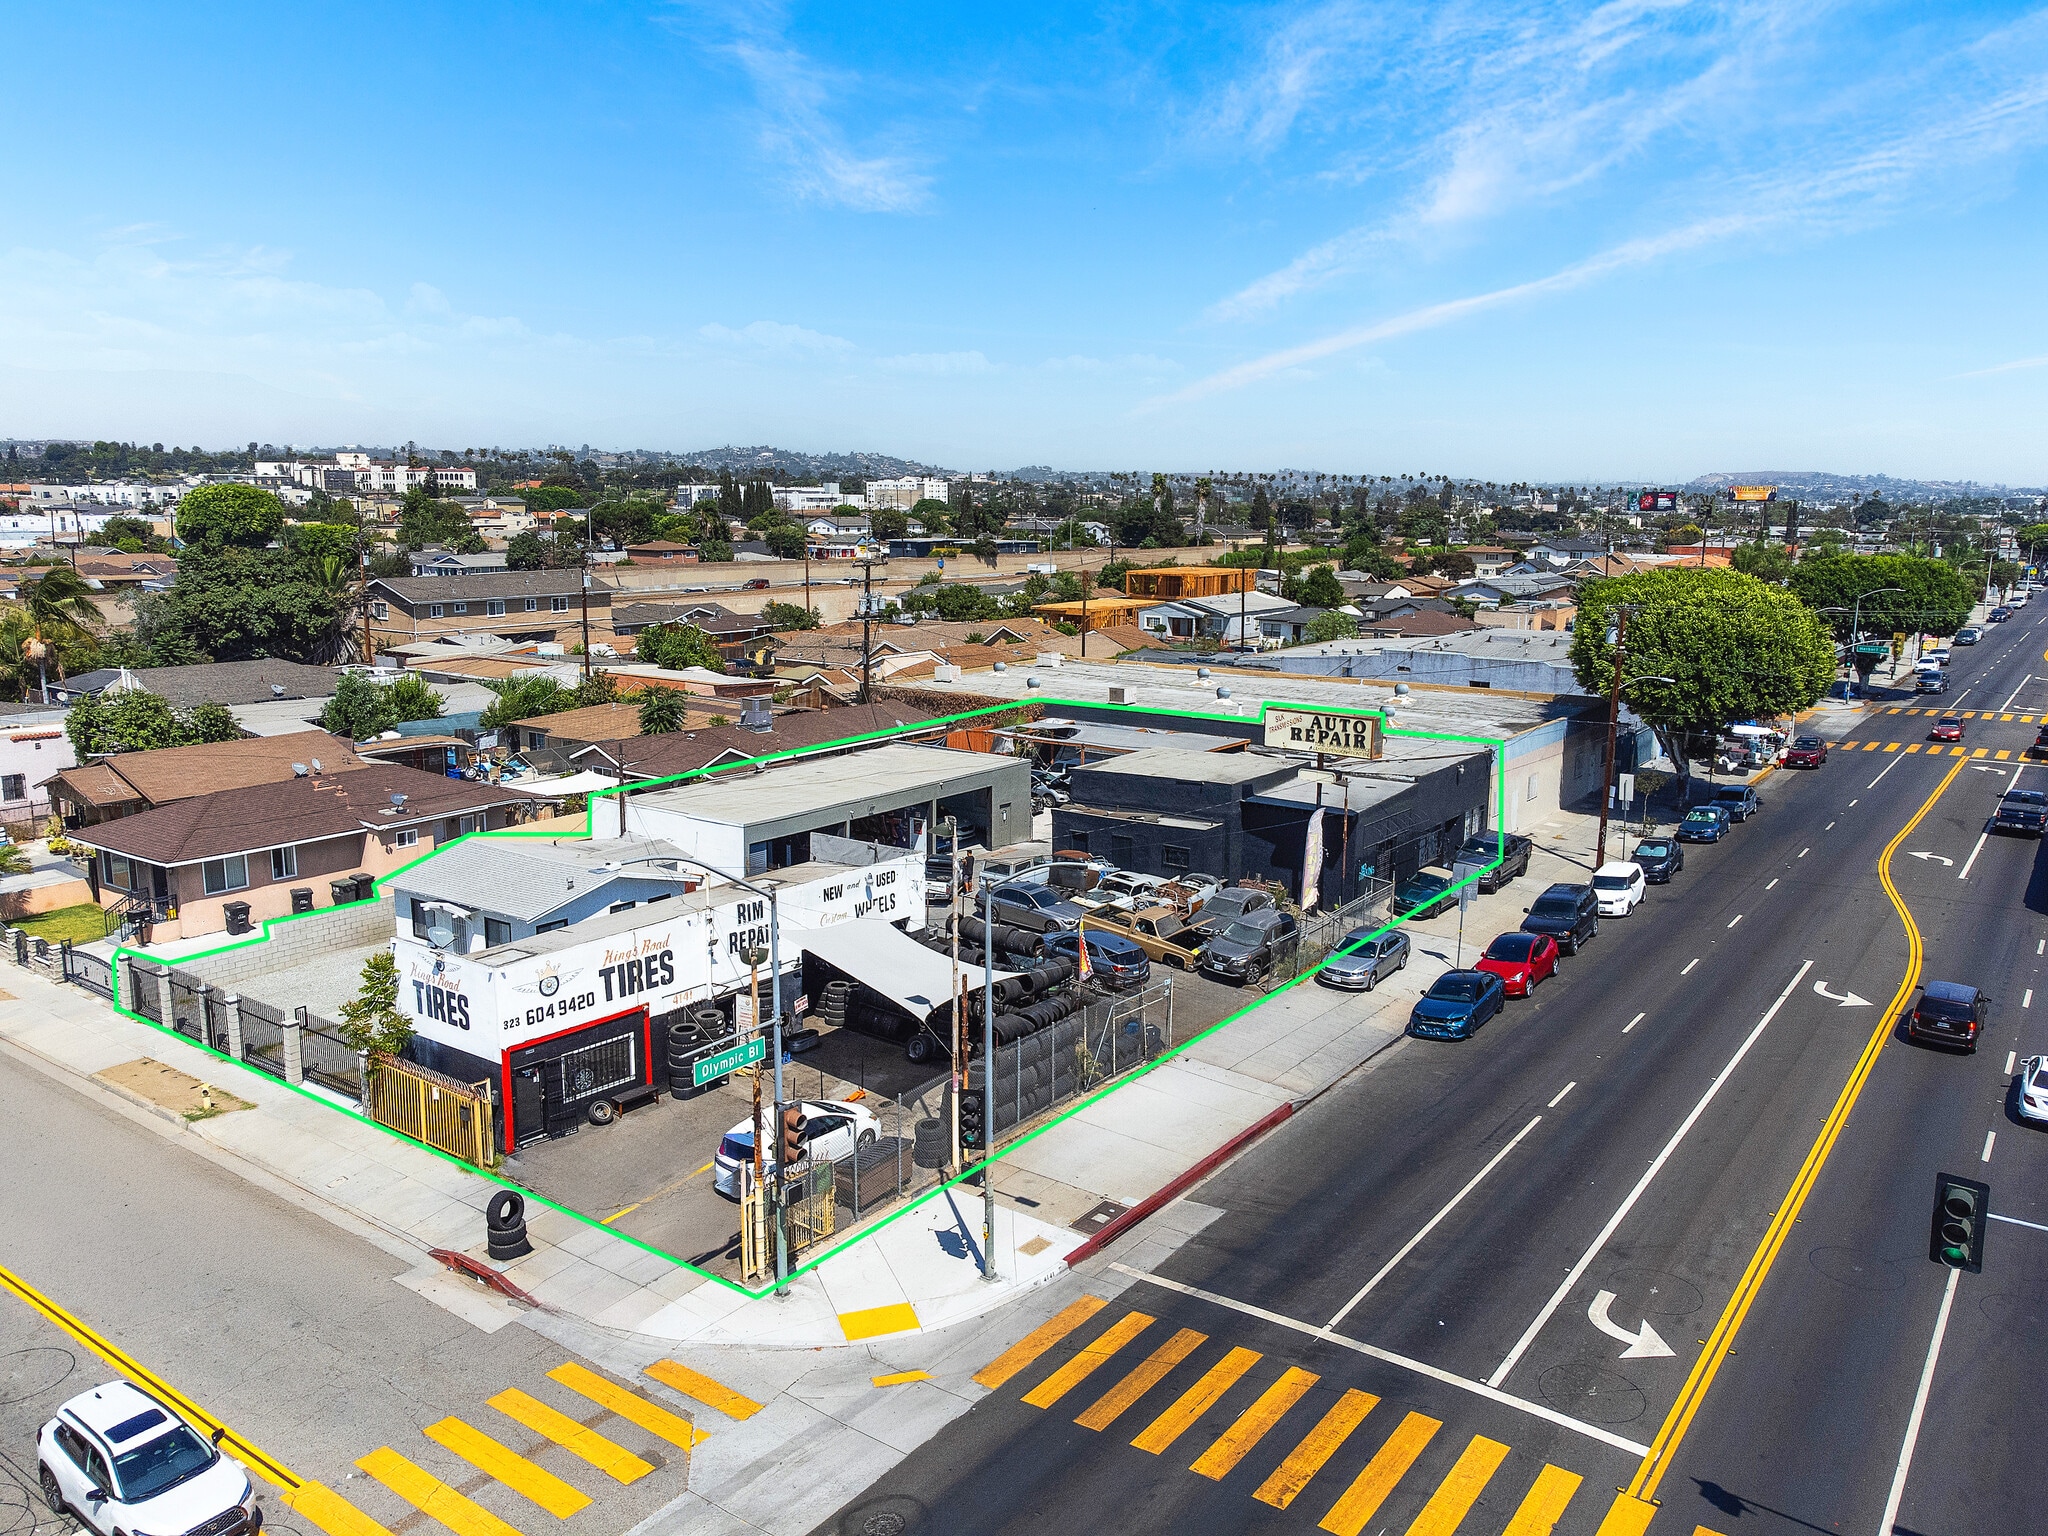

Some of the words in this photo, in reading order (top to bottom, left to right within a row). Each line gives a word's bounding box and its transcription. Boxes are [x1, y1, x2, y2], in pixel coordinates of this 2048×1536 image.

[1311, 715, 1367, 734] AUTO
[1290, 727, 1366, 749] REPAIR
[823, 884, 844, 903] NEW
[846, 879, 861, 890] and
[875, 870, 896, 888] USED
[736, 900, 764, 925] RIM
[641, 932, 671, 956] Road
[437, 972, 461, 992] Road
[599, 949, 675, 1002] TIRES
[412, 979, 471, 1031] TIRES
[672, 989, 693, 1005] 4141
[503, 1017, 520, 1030] 323
[526, 1003, 555, 1026] 604
[558, 991, 595, 1016] 9420
[702, 1052, 744, 1078] Olympic
